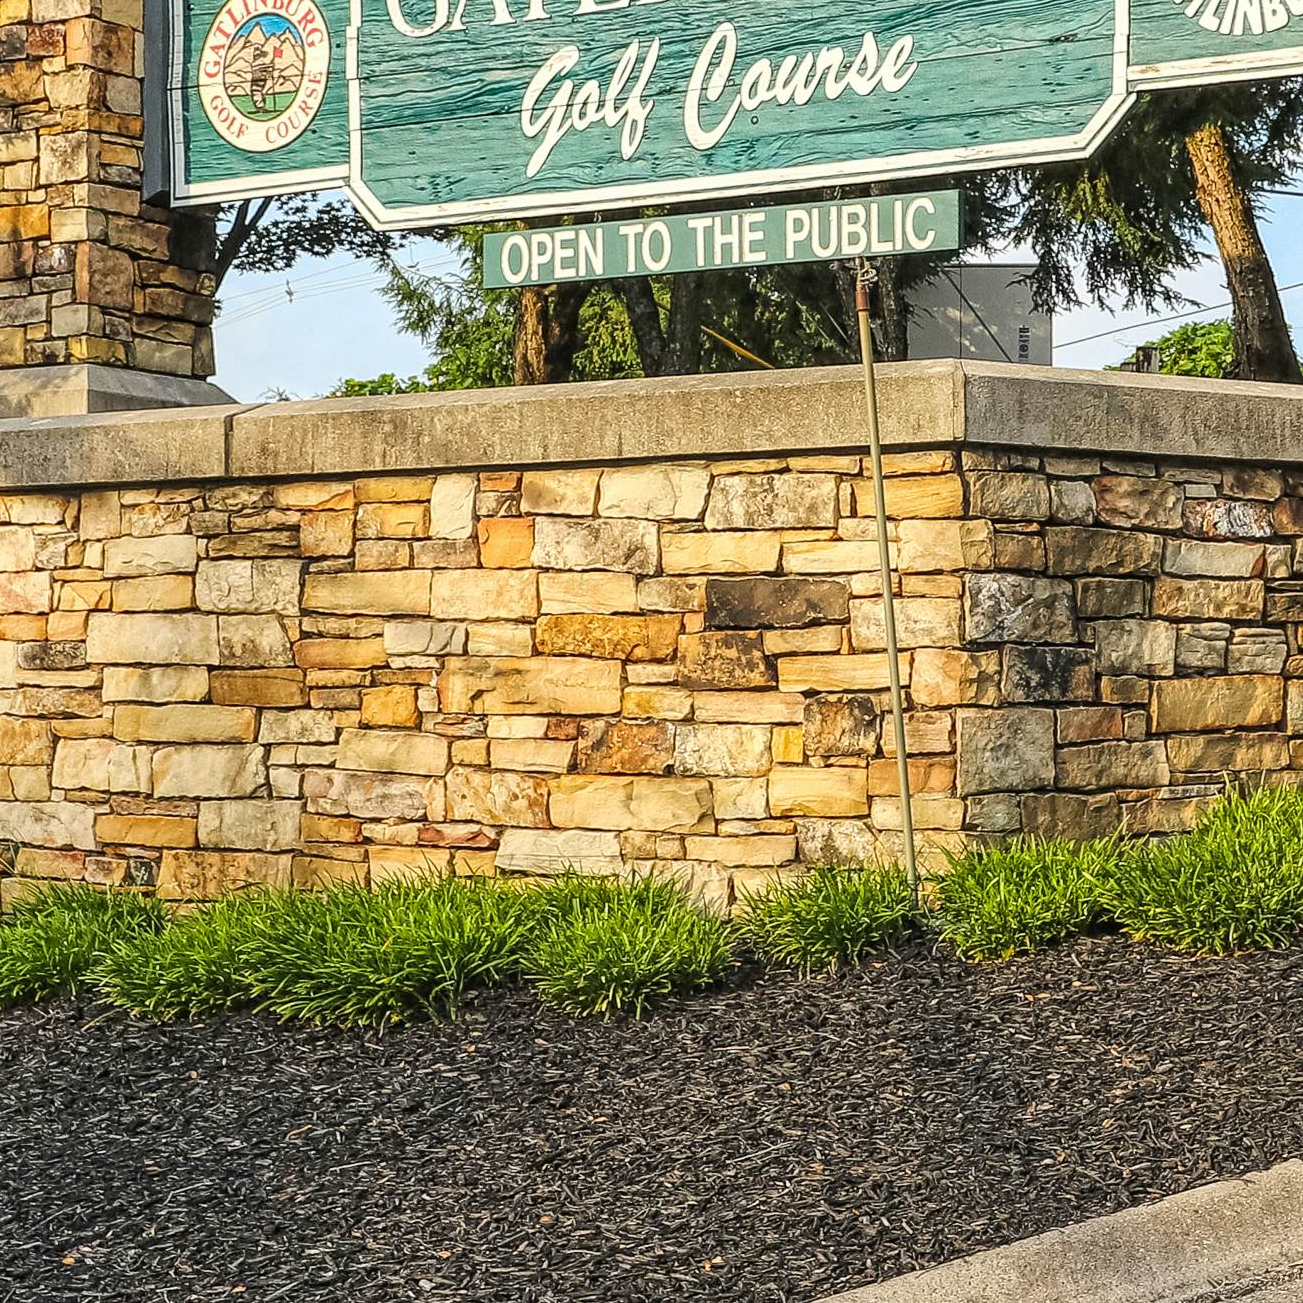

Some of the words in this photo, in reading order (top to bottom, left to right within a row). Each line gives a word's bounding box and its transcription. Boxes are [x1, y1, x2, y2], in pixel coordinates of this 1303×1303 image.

[209, 94, 249, 140] GOLF
[264, 70, 323, 144] COURSE
[520, 35, 662, 179] Golf
[683, 21, 919, 151] Course
[499, 227, 605, 285] OPEN
[618, 220, 673, 274] TO
[688, 211, 769, 267] THE
[784, 197, 937, 259] PUBLIC
